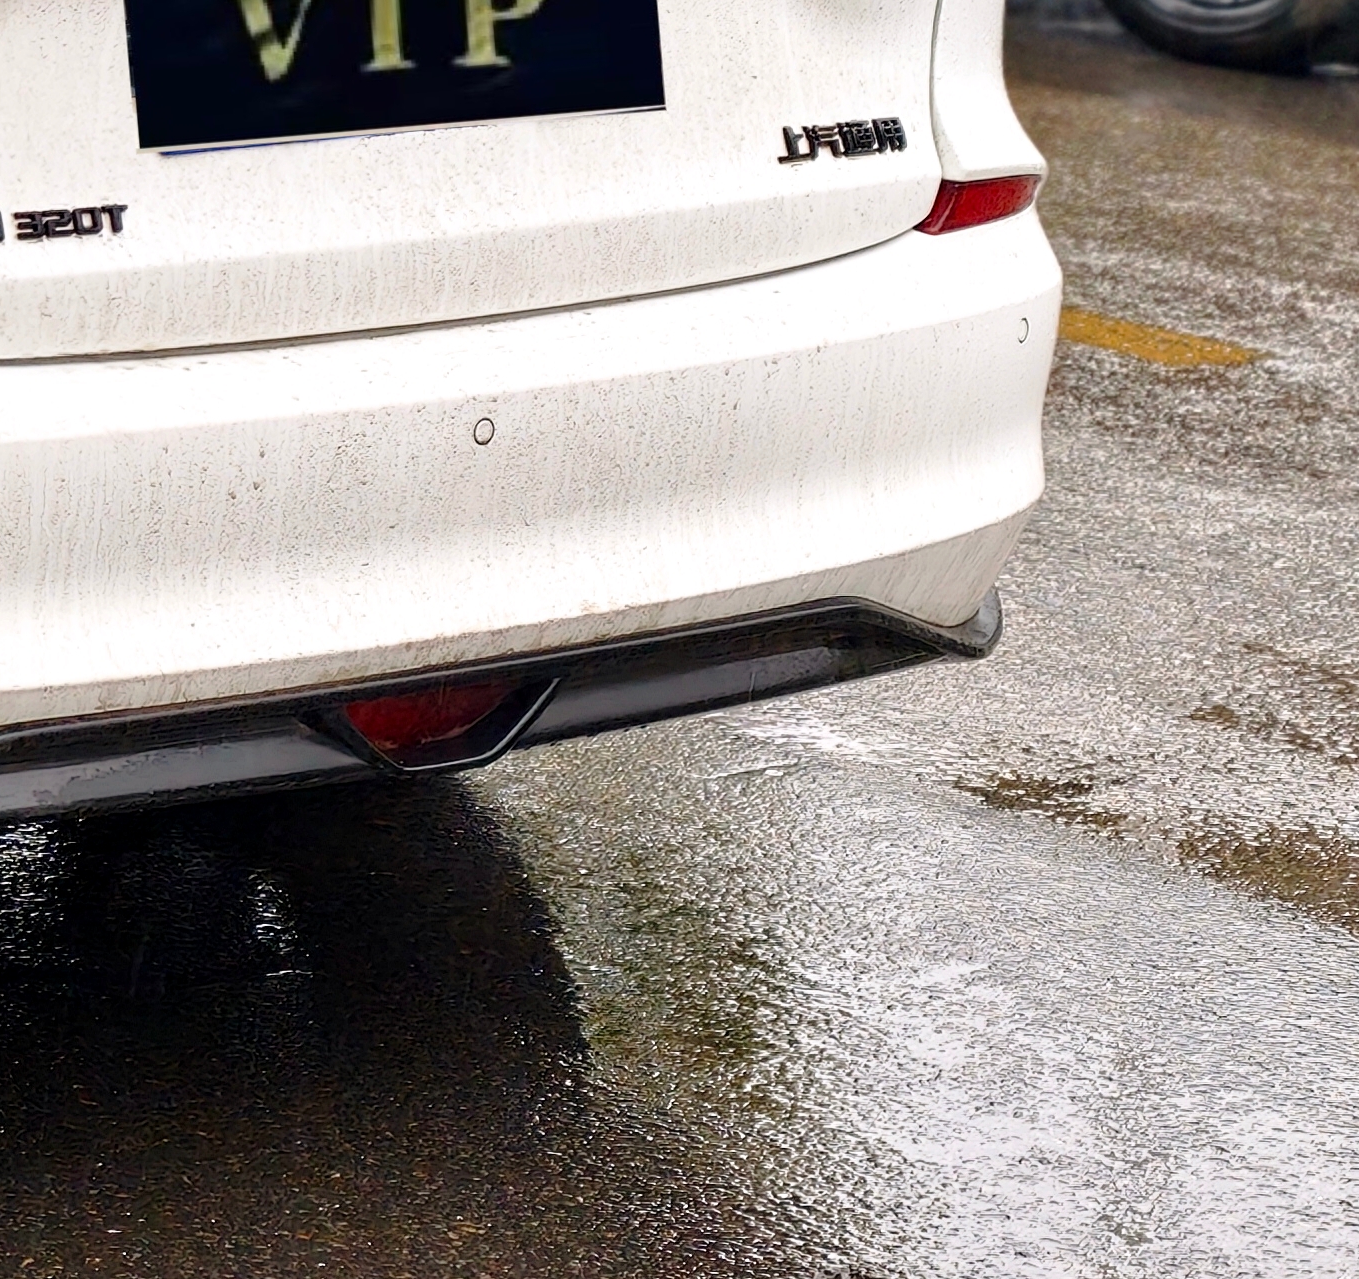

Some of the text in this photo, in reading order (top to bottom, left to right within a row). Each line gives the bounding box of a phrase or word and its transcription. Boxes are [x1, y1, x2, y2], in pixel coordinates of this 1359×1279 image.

[777, 116, 908, 165] 上汽通用
[12, 203, 129, 242] 320T
